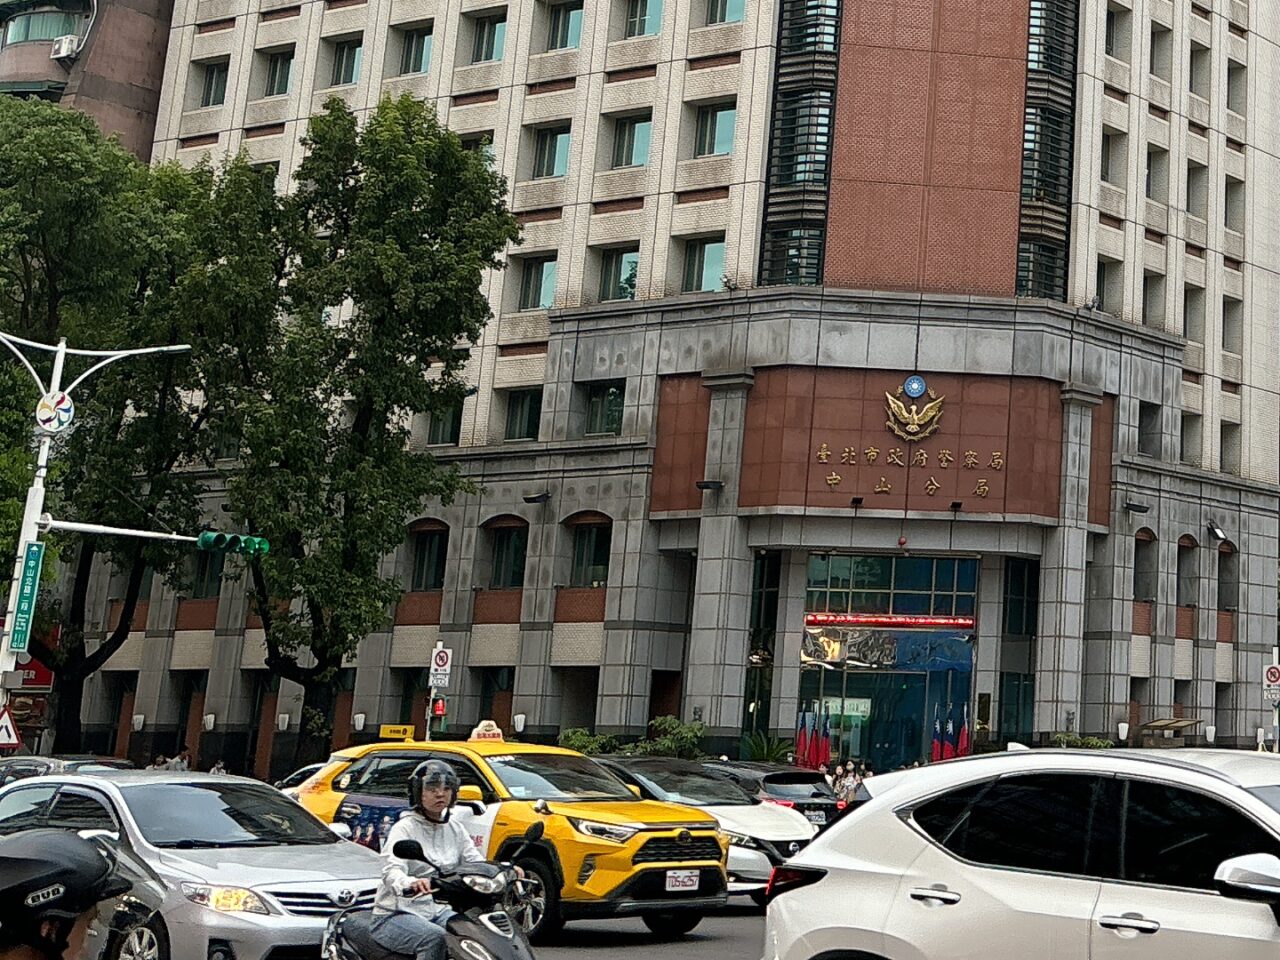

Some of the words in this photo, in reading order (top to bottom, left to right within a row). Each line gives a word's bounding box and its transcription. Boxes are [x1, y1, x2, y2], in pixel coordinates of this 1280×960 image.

[815, 442, 1004, 471] 臺北市政府警察局
[825, 471, 990, 498] 中山分局
